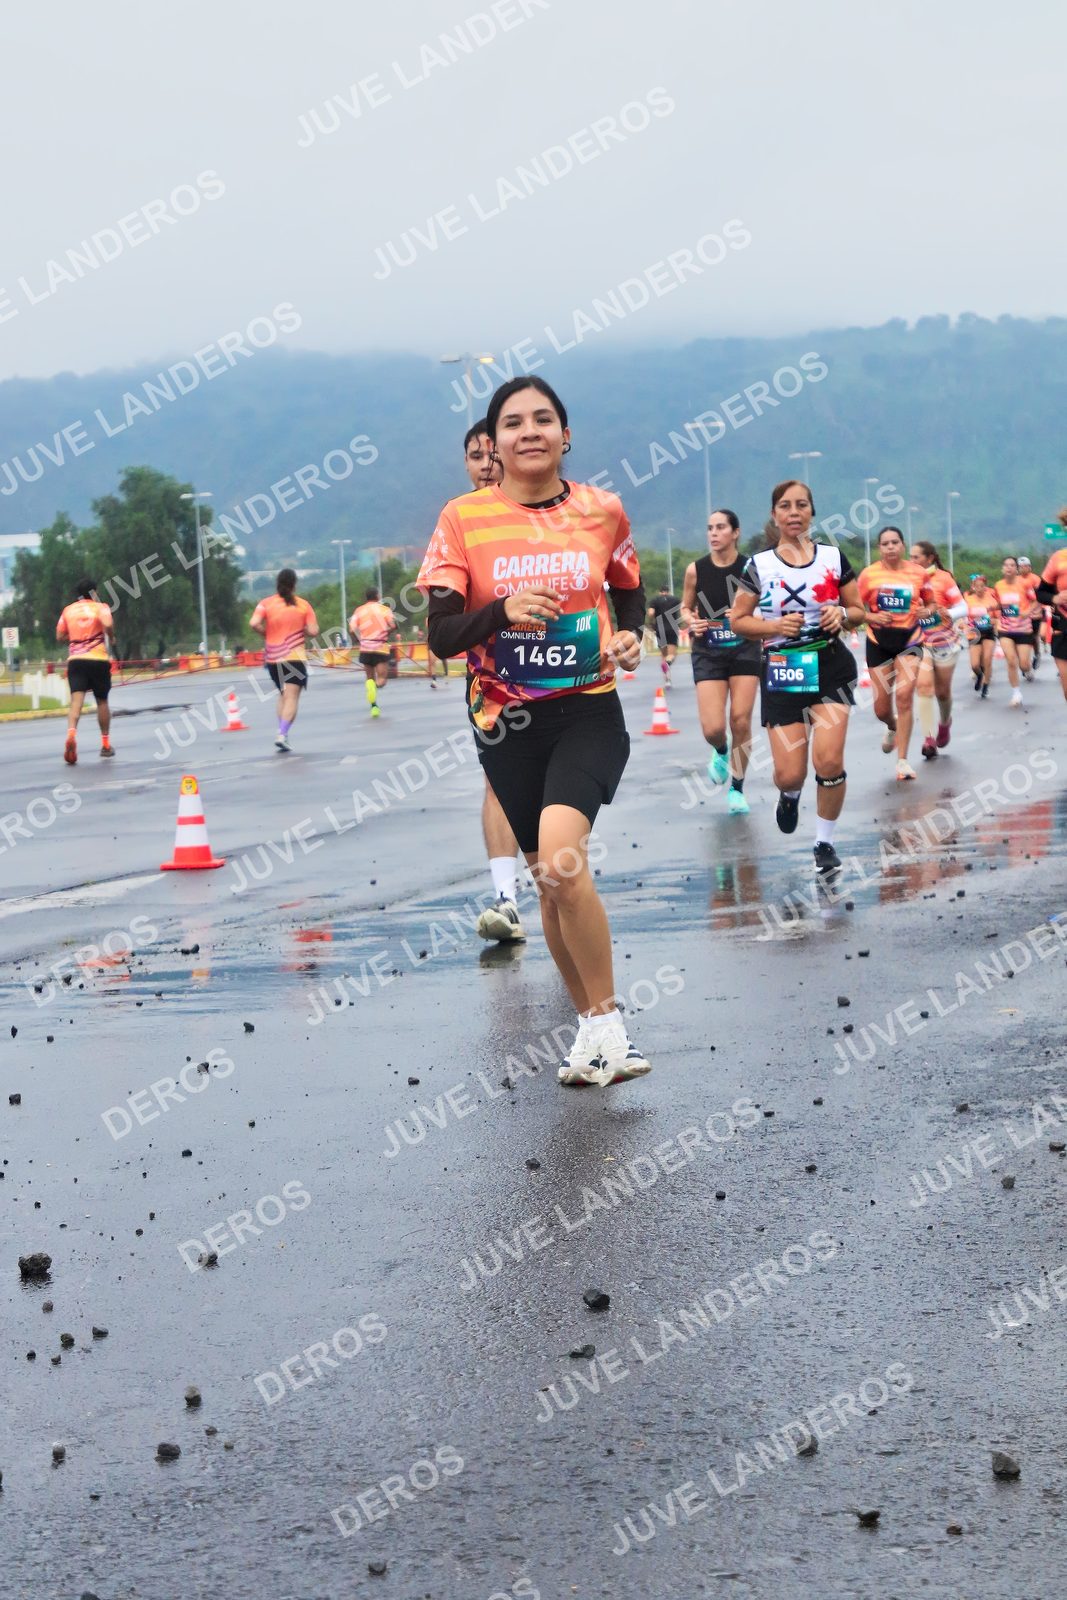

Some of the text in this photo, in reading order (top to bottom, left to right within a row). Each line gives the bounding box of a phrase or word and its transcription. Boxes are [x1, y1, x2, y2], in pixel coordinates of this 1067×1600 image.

[493, 551, 590, 580] CARRERA
[576, 615, 591, 632] 10K
[514, 644, 577, 667] 1462
[773, 668, 804, 682] 1506
